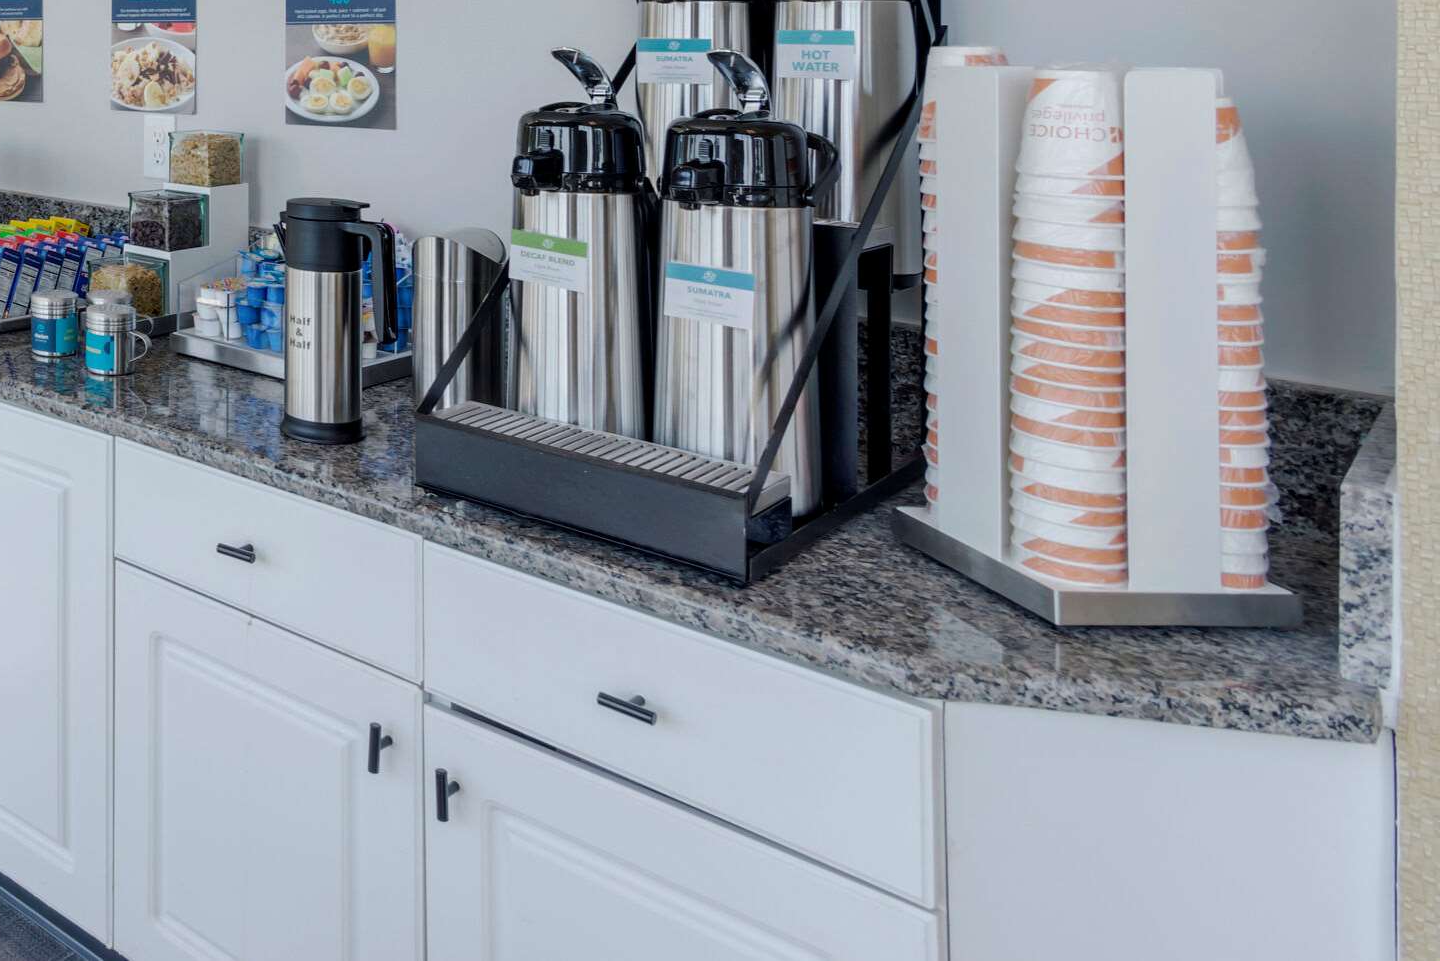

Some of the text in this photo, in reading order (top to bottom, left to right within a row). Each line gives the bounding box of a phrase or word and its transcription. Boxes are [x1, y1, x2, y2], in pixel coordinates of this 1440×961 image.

[655, 55, 694, 63] SUMATRA
[800, 49, 831, 60] HOT
[792, 61, 841, 73] WATER
[1029, 124, 1106, 143] CHOICE
[548, 255, 576, 267] BLEND
[687, 285, 732, 300] SUMATRA
[289, 314, 311, 326] Half
[295, 327, 304, 336] &
[289, 338, 311, 350] Half
